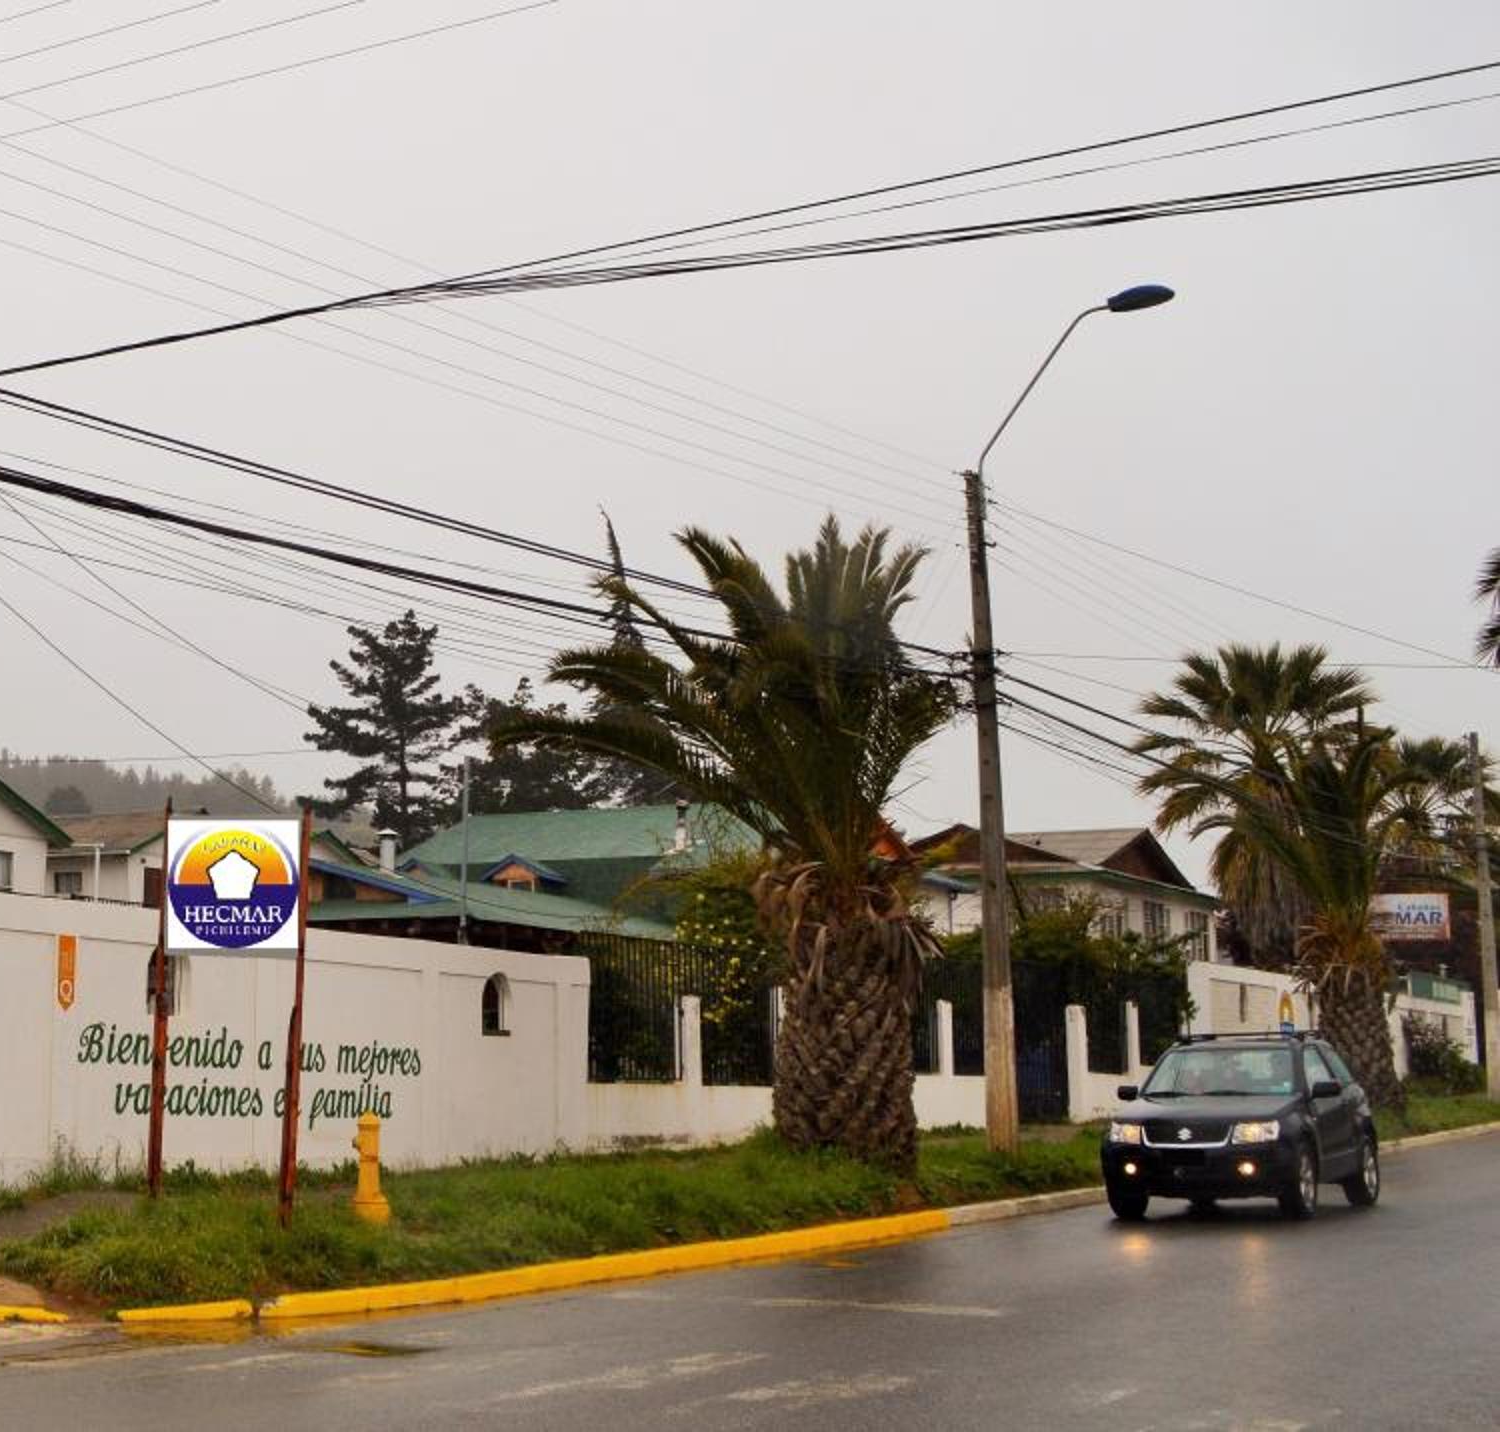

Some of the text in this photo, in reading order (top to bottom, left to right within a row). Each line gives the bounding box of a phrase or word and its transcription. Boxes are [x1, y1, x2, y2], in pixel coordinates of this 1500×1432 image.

[183, 904, 284, 924] HECMAR
[195, 923, 273, 937] PICHILEMU
[77, 1023, 421, 1082] Bienenido a us mejores
[114, 1077, 393, 1132] vaaciones e familia
